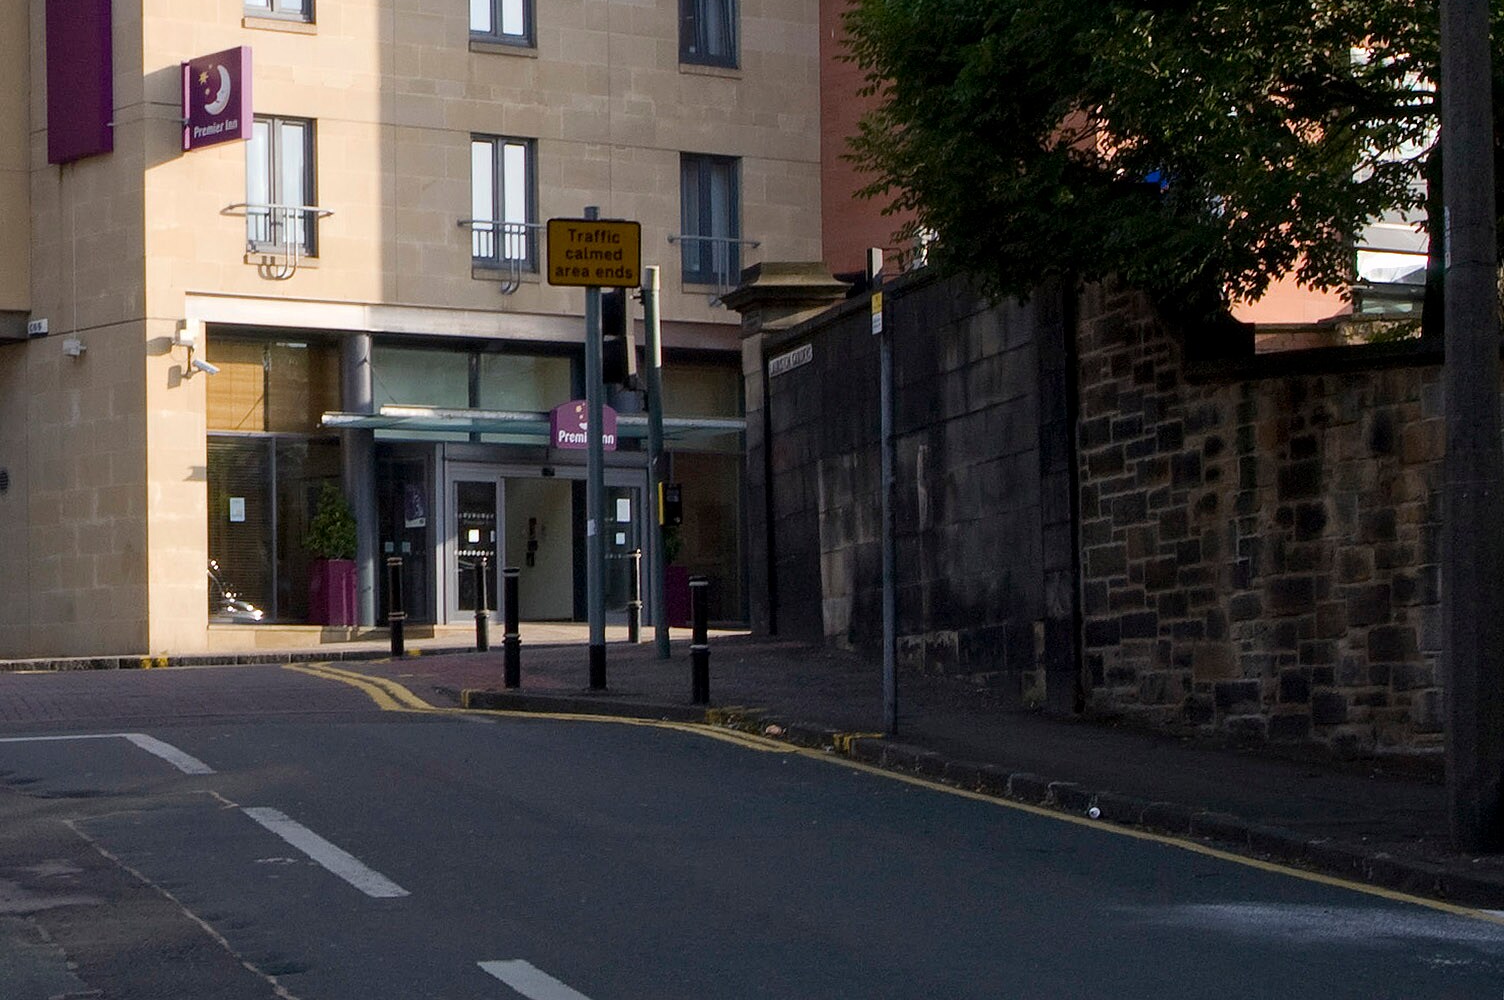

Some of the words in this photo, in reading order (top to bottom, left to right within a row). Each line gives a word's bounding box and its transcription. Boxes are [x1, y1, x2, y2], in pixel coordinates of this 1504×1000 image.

[194, 122, 224, 138] Premier
[225, 120, 237, 131] Inn
[568, 228, 620, 243] Traffic
[565, 247, 622, 260] calmed
[556, 266, 590, 278] area
[596, 265, 633, 279] ends
[558, 430, 587, 443] Premi
